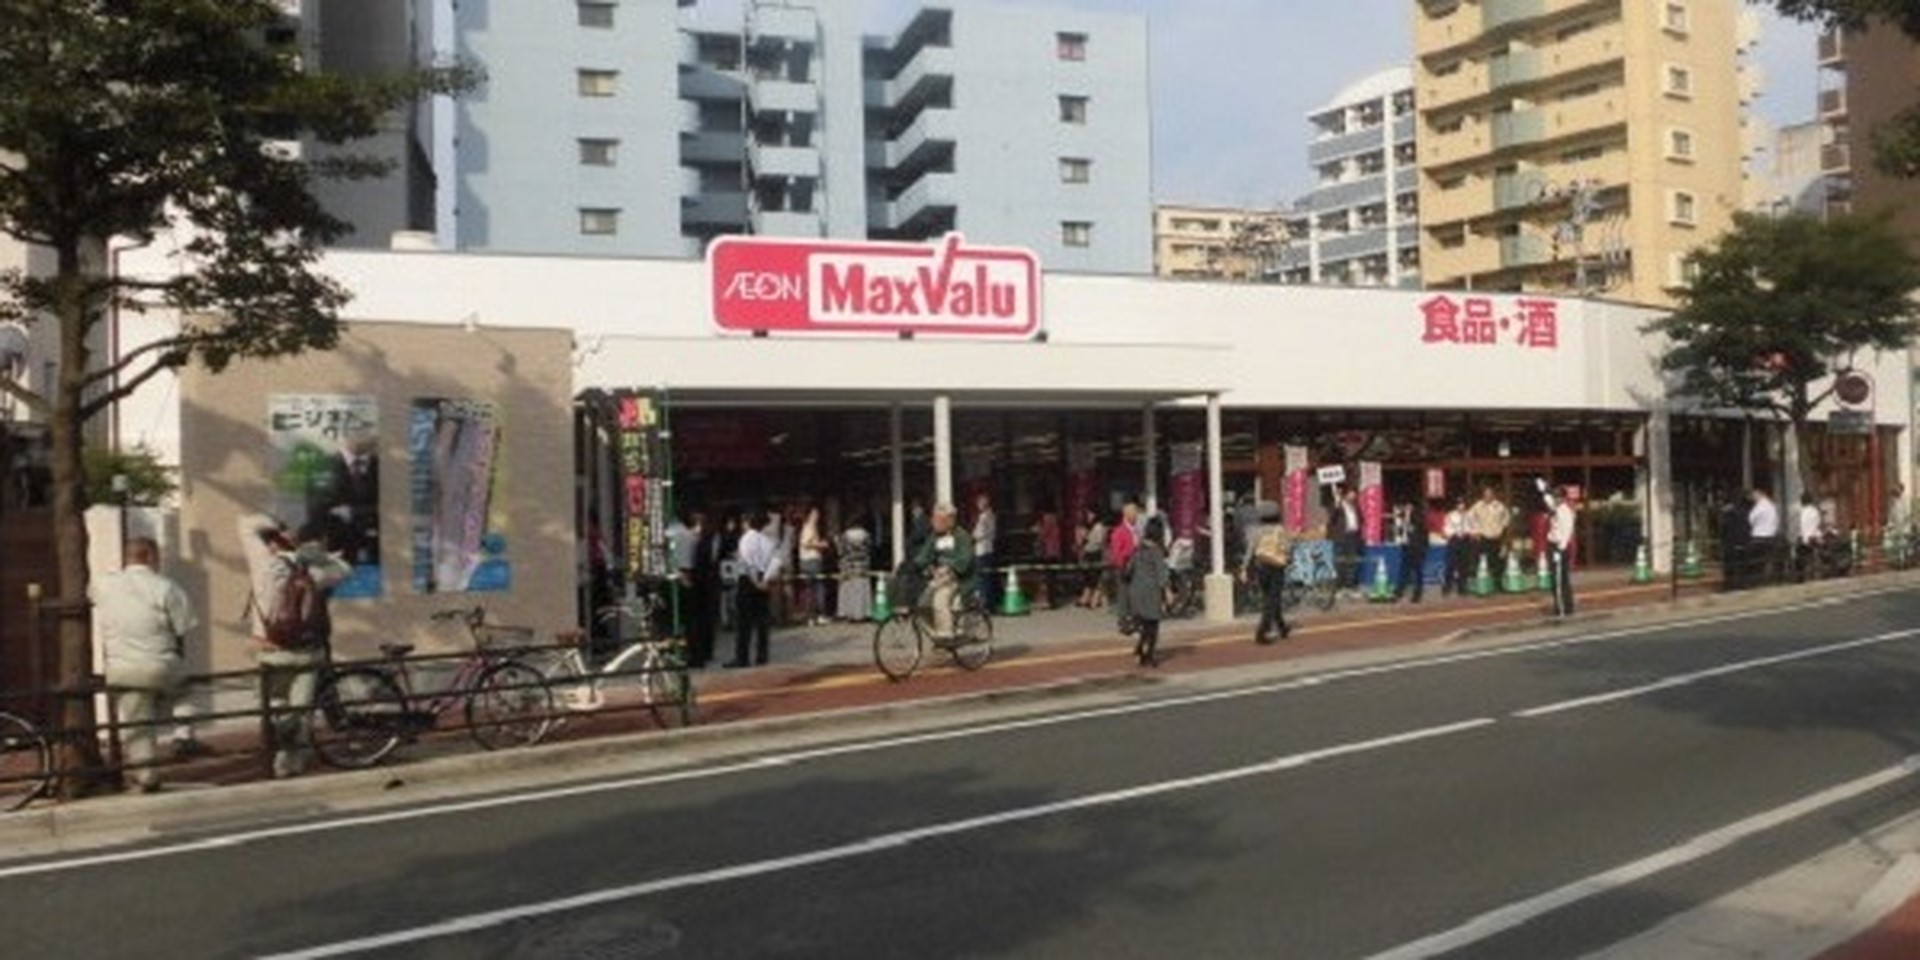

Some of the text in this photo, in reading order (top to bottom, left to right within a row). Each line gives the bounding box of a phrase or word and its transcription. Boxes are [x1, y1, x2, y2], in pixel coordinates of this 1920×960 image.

[820, 237, 1016, 317] MaxValu
[1420, 295, 1557, 347] 食品・酒
